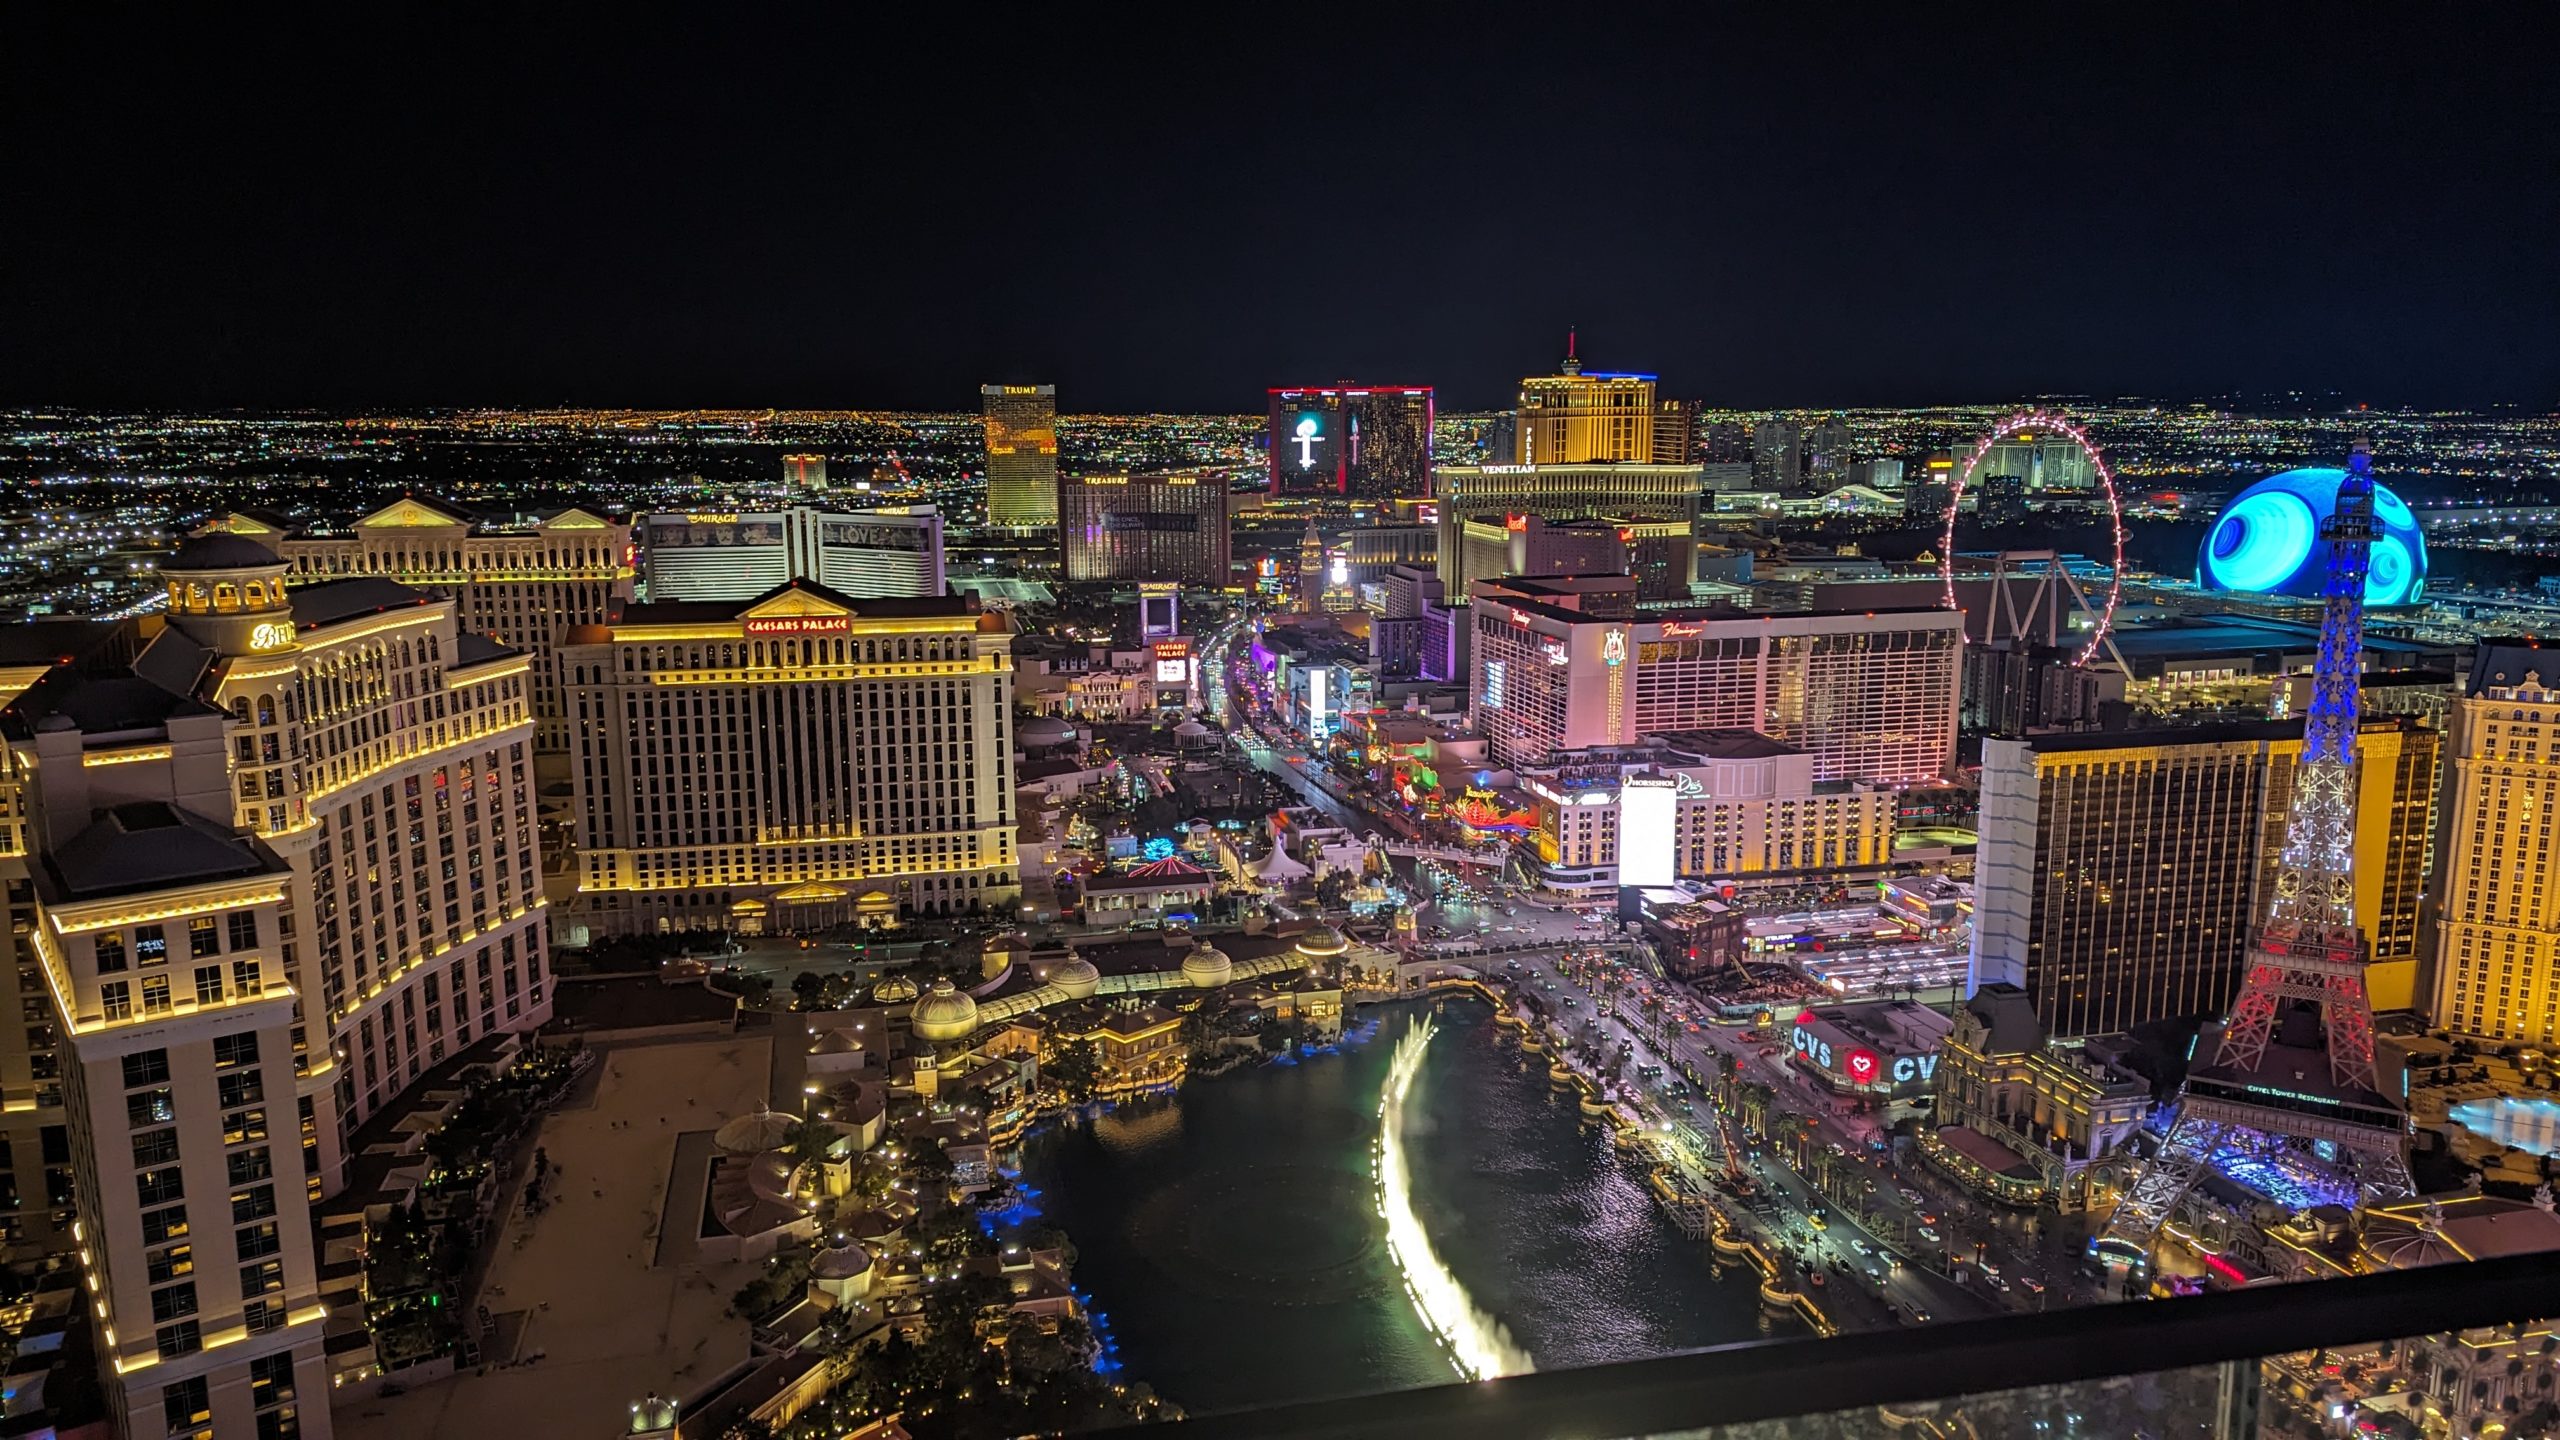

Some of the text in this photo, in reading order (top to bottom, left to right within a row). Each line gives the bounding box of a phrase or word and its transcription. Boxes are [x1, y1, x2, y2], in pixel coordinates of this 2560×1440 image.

[1004, 386, 1036, 394] TRUMP
[1481, 464, 1536, 474] VENETIAN
[1085, 477, 1128, 485] TREASURE
[692, 514, 738, 524] MIRAGE
[840, 526, 878, 545] LOVE
[748, 620, 847, 631] CAESARS PALACE
[1662, 622, 1703, 638] Flamingo
[1793, 1026, 1832, 1068] CVS
[1893, 1055, 1938, 1082] CV
[2297, 1093, 2341, 1106] RESTAURANT
